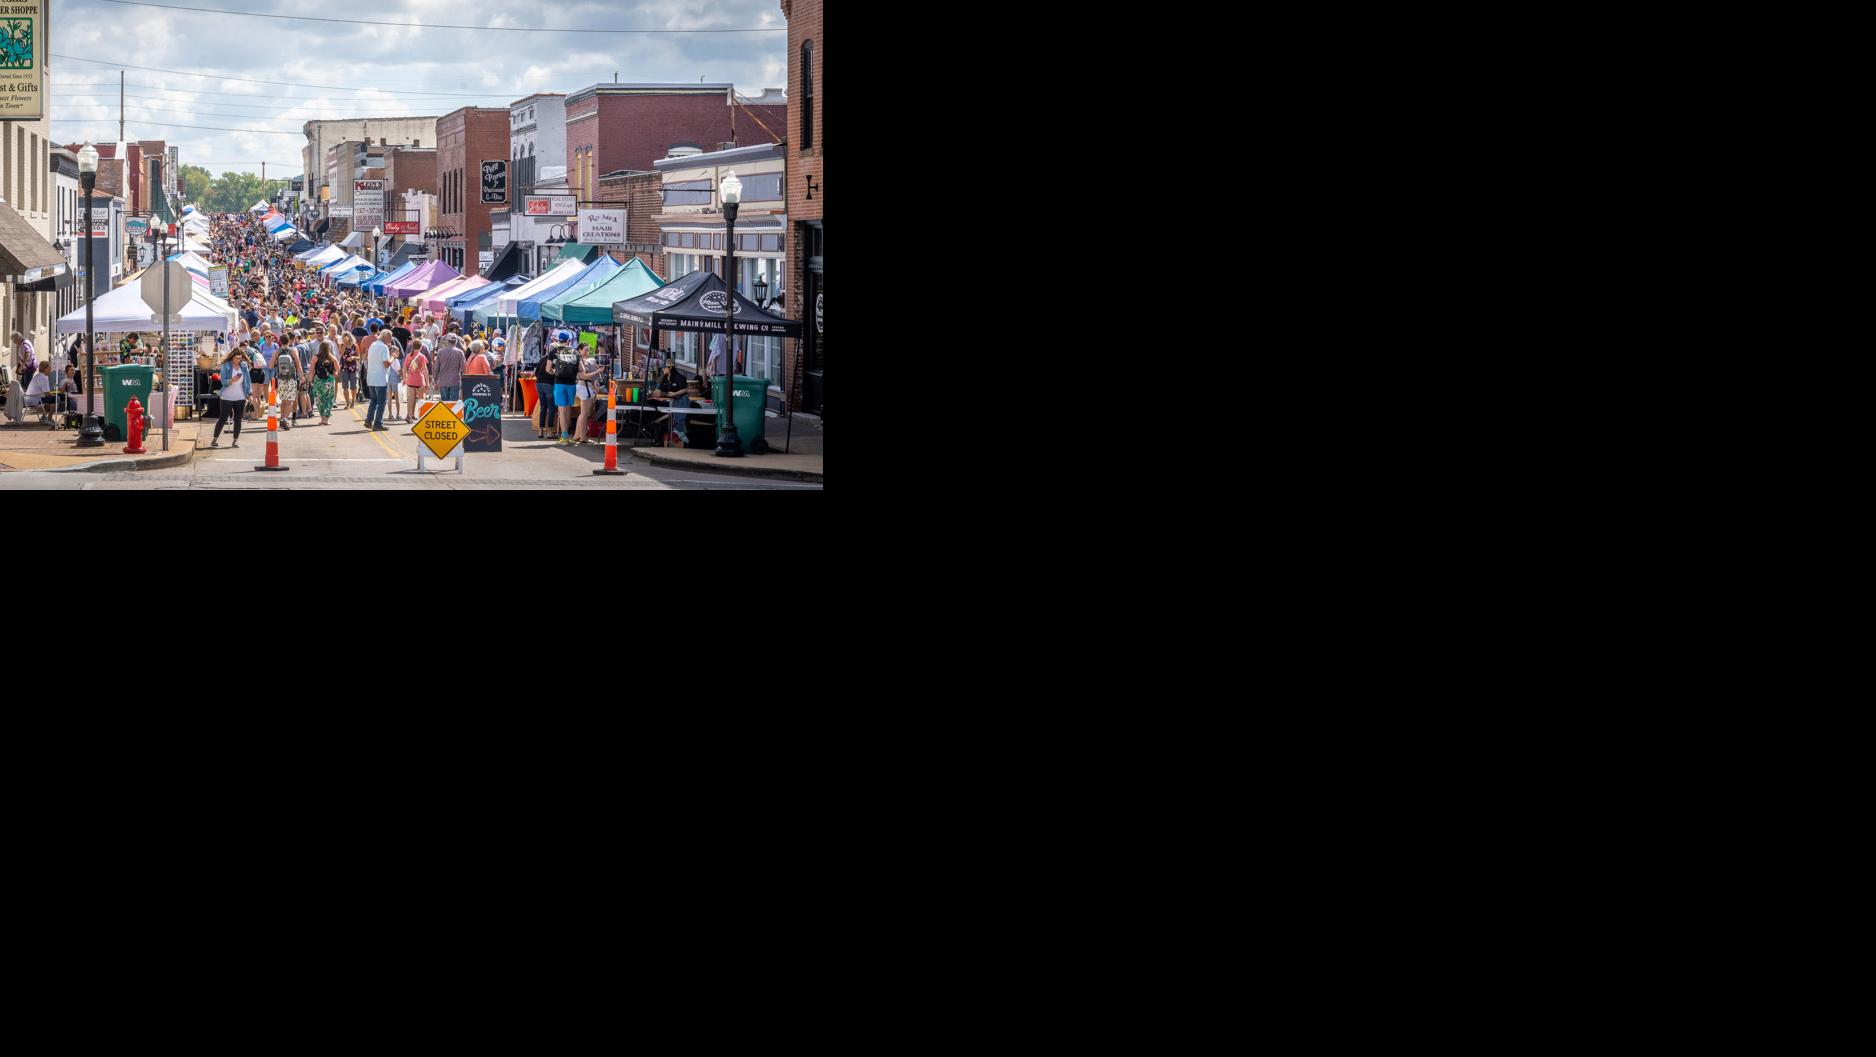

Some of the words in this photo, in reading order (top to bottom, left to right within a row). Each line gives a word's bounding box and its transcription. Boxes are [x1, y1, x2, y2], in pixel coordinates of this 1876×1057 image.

[11, 6, 38, 14] SHOPPE
[8, 83, 16, 92] &
[17, 82, 38, 92] Gifts
[464, 398, 501, 423] Beer
[425, 421, 457, 429] STREET
[424, 432, 458, 440] CLOSED
